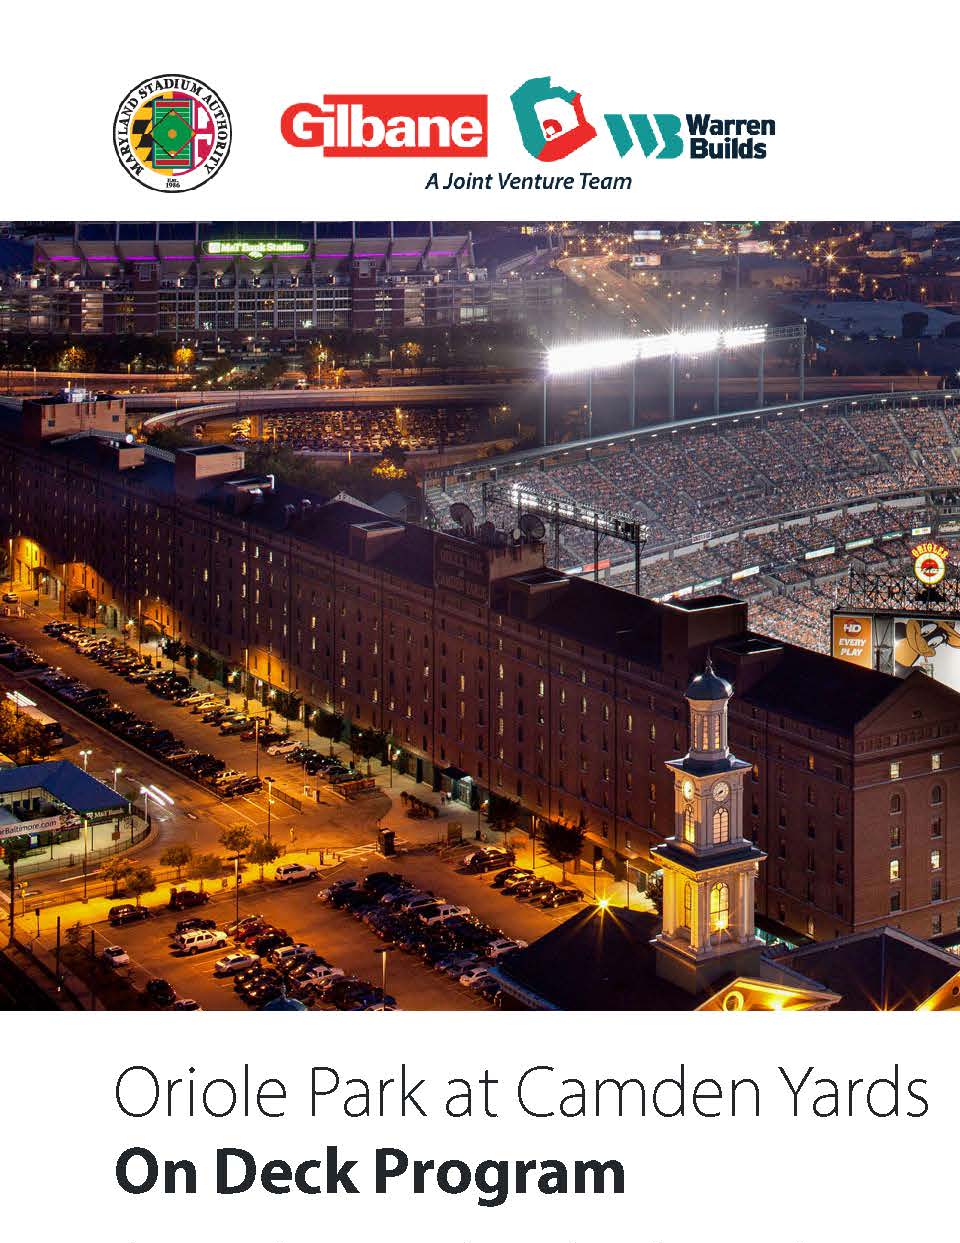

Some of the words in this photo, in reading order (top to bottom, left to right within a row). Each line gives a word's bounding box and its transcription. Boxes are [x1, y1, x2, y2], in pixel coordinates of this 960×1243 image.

[118, 97, 144, 176] MARYLAND
[138, 78, 203, 99] STADIUM
[202, 94, 228, 174] AUTHORITY
[281, 103, 483, 148] Gilbane
[685, 114, 776, 135] Warren
[690, 137, 767, 159] Builds
[425, 173, 439, 189] A
[443, 173, 493, 189] Joint
[499, 173, 574, 189] Venture
[580, 173, 632, 189] Team
[843, 623, 862, 633] HD
[839, 638, 866, 647] EVERY
[840, 647, 863, 656] PLAY
[116, 1064, 286, 1117] Oriole
[312, 1064, 427, 1117] Park
[446, 1070, 498, 1117] at
[518, 1064, 759, 1117] Camden
[778, 1064, 928, 1117] Yards
[116, 1147, 196, 1194] On
[217, 1146, 360, 1194] Deck
[376, 1148, 624, 1207] Program
